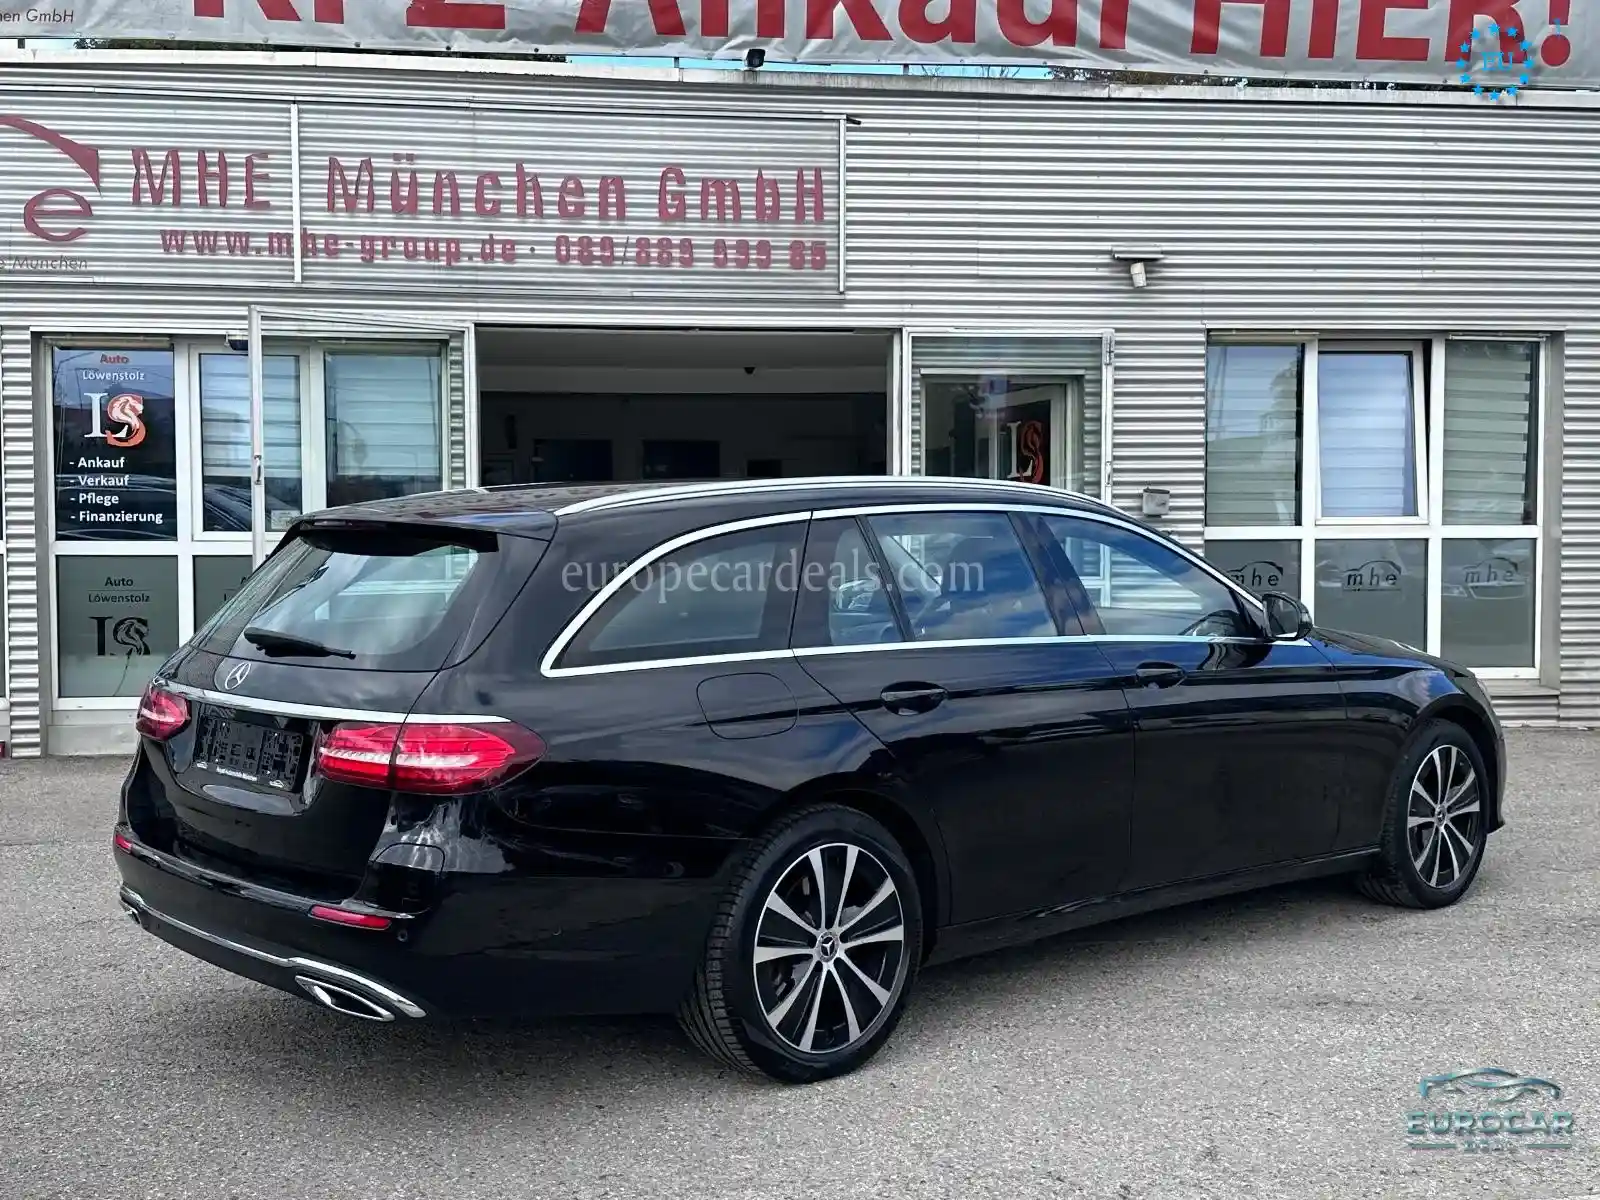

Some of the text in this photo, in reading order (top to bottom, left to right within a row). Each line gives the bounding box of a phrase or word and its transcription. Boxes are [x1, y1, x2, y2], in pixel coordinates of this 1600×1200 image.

[26, 8, 74, 23] GmbH
[131, 149, 824, 222] MHE München GmbH
[160, 227, 515, 266] www.mhe-group.de
[100, 354, 129, 364] Auto
[82, 369, 145, 380] Löwenstolz
[78, 457, 125, 468] Ankauf
[78, 475, 129, 486] Verkauf
[79, 492, 119, 506] Pflege
[79, 511, 163, 524] Finanzierung
[1347, 567, 1397, 586] mhe
[1465, 564, 1514, 583] mhe
[105, 577, 133, 586] Auto
[88, 593, 150, 603] Löwenstolz
